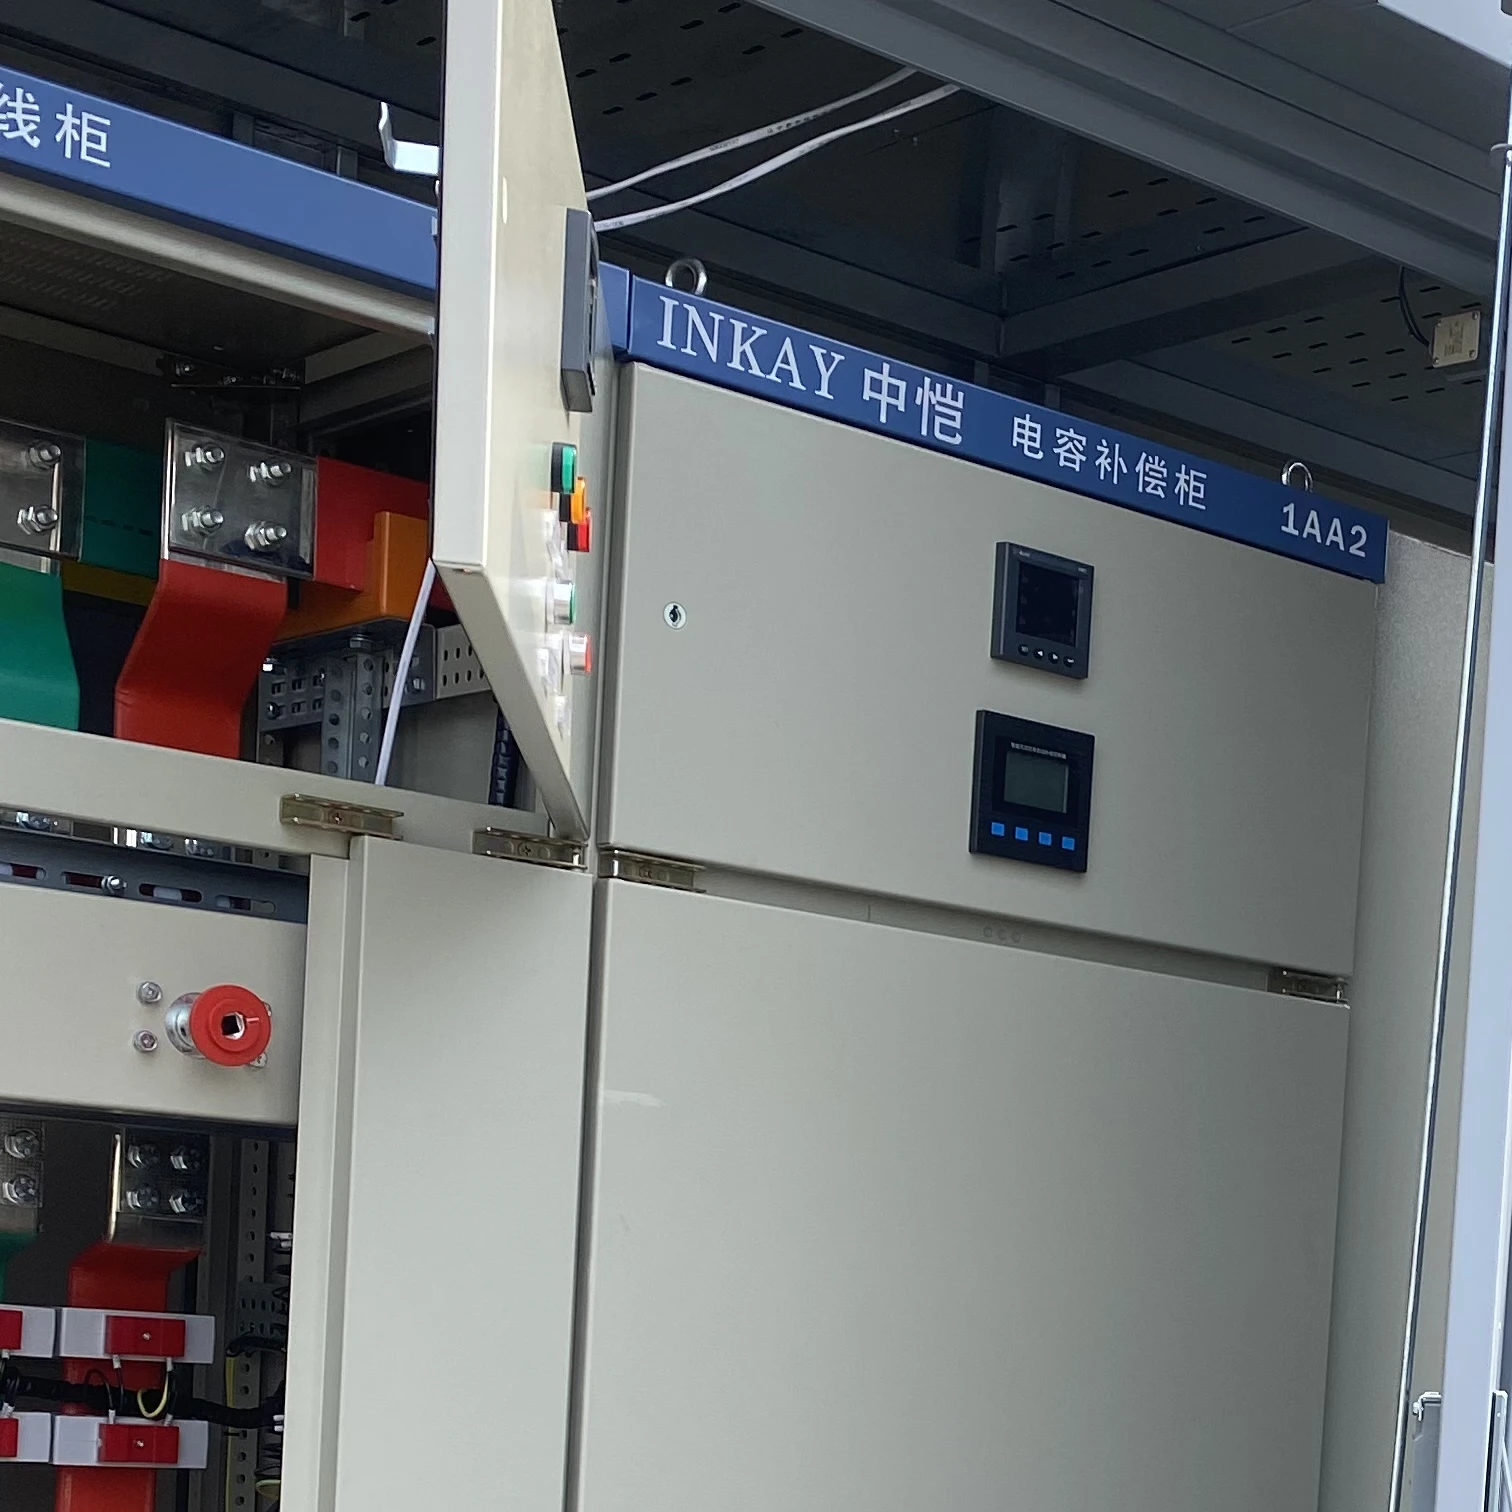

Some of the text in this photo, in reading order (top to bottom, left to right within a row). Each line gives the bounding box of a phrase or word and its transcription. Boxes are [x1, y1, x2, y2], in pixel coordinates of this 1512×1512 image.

[0, 82, 111, 169] 线柜
[656, 295, 1368, 558] INKAY 中恺 电容补偿柜 1AA2
